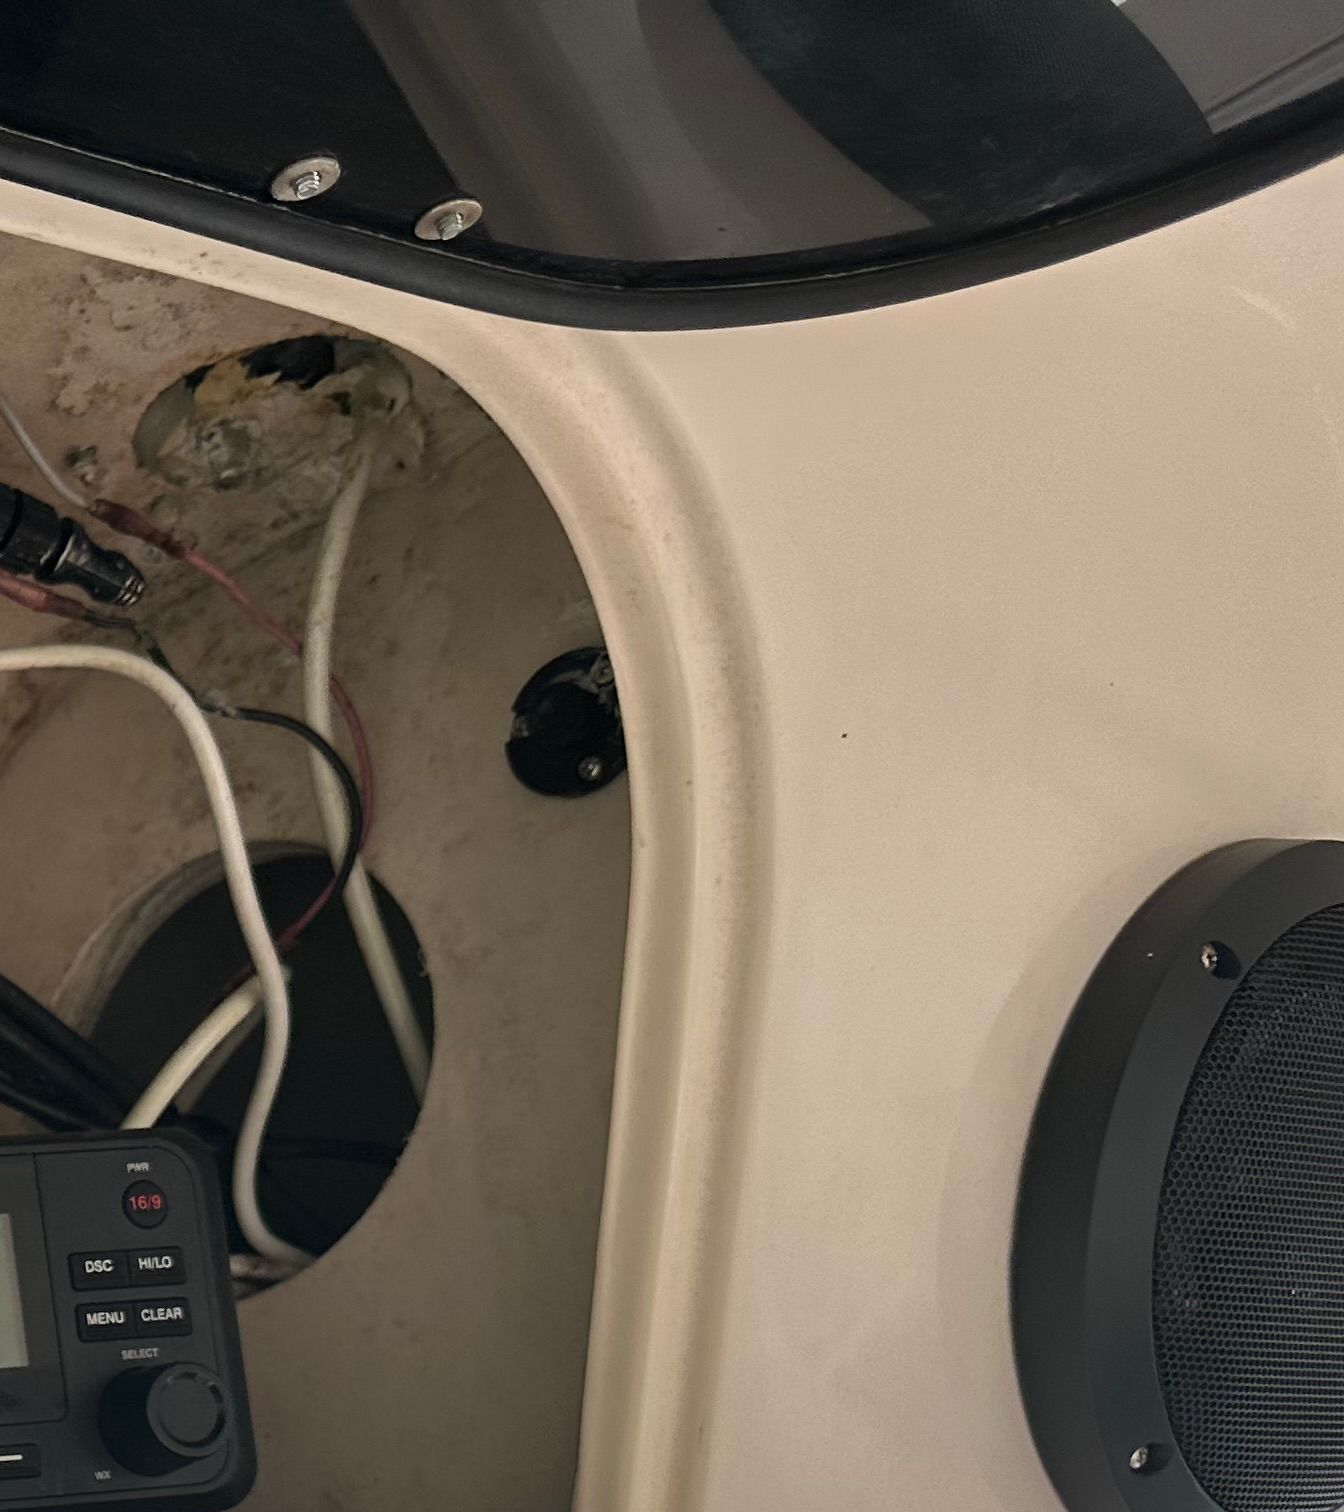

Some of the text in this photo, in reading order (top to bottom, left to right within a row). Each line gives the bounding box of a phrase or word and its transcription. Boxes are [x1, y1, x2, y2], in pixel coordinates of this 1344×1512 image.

[127, 1162, 149, 1172] PWR
[129, 1194, 161, 1210] 16/9
[85, 1260, 113, 1273] DSC
[86, 1312, 124, 1325] MENU
[141, 1307, 182, 1321] CLEAR
[121, 1348, 159, 1360] SELECT
